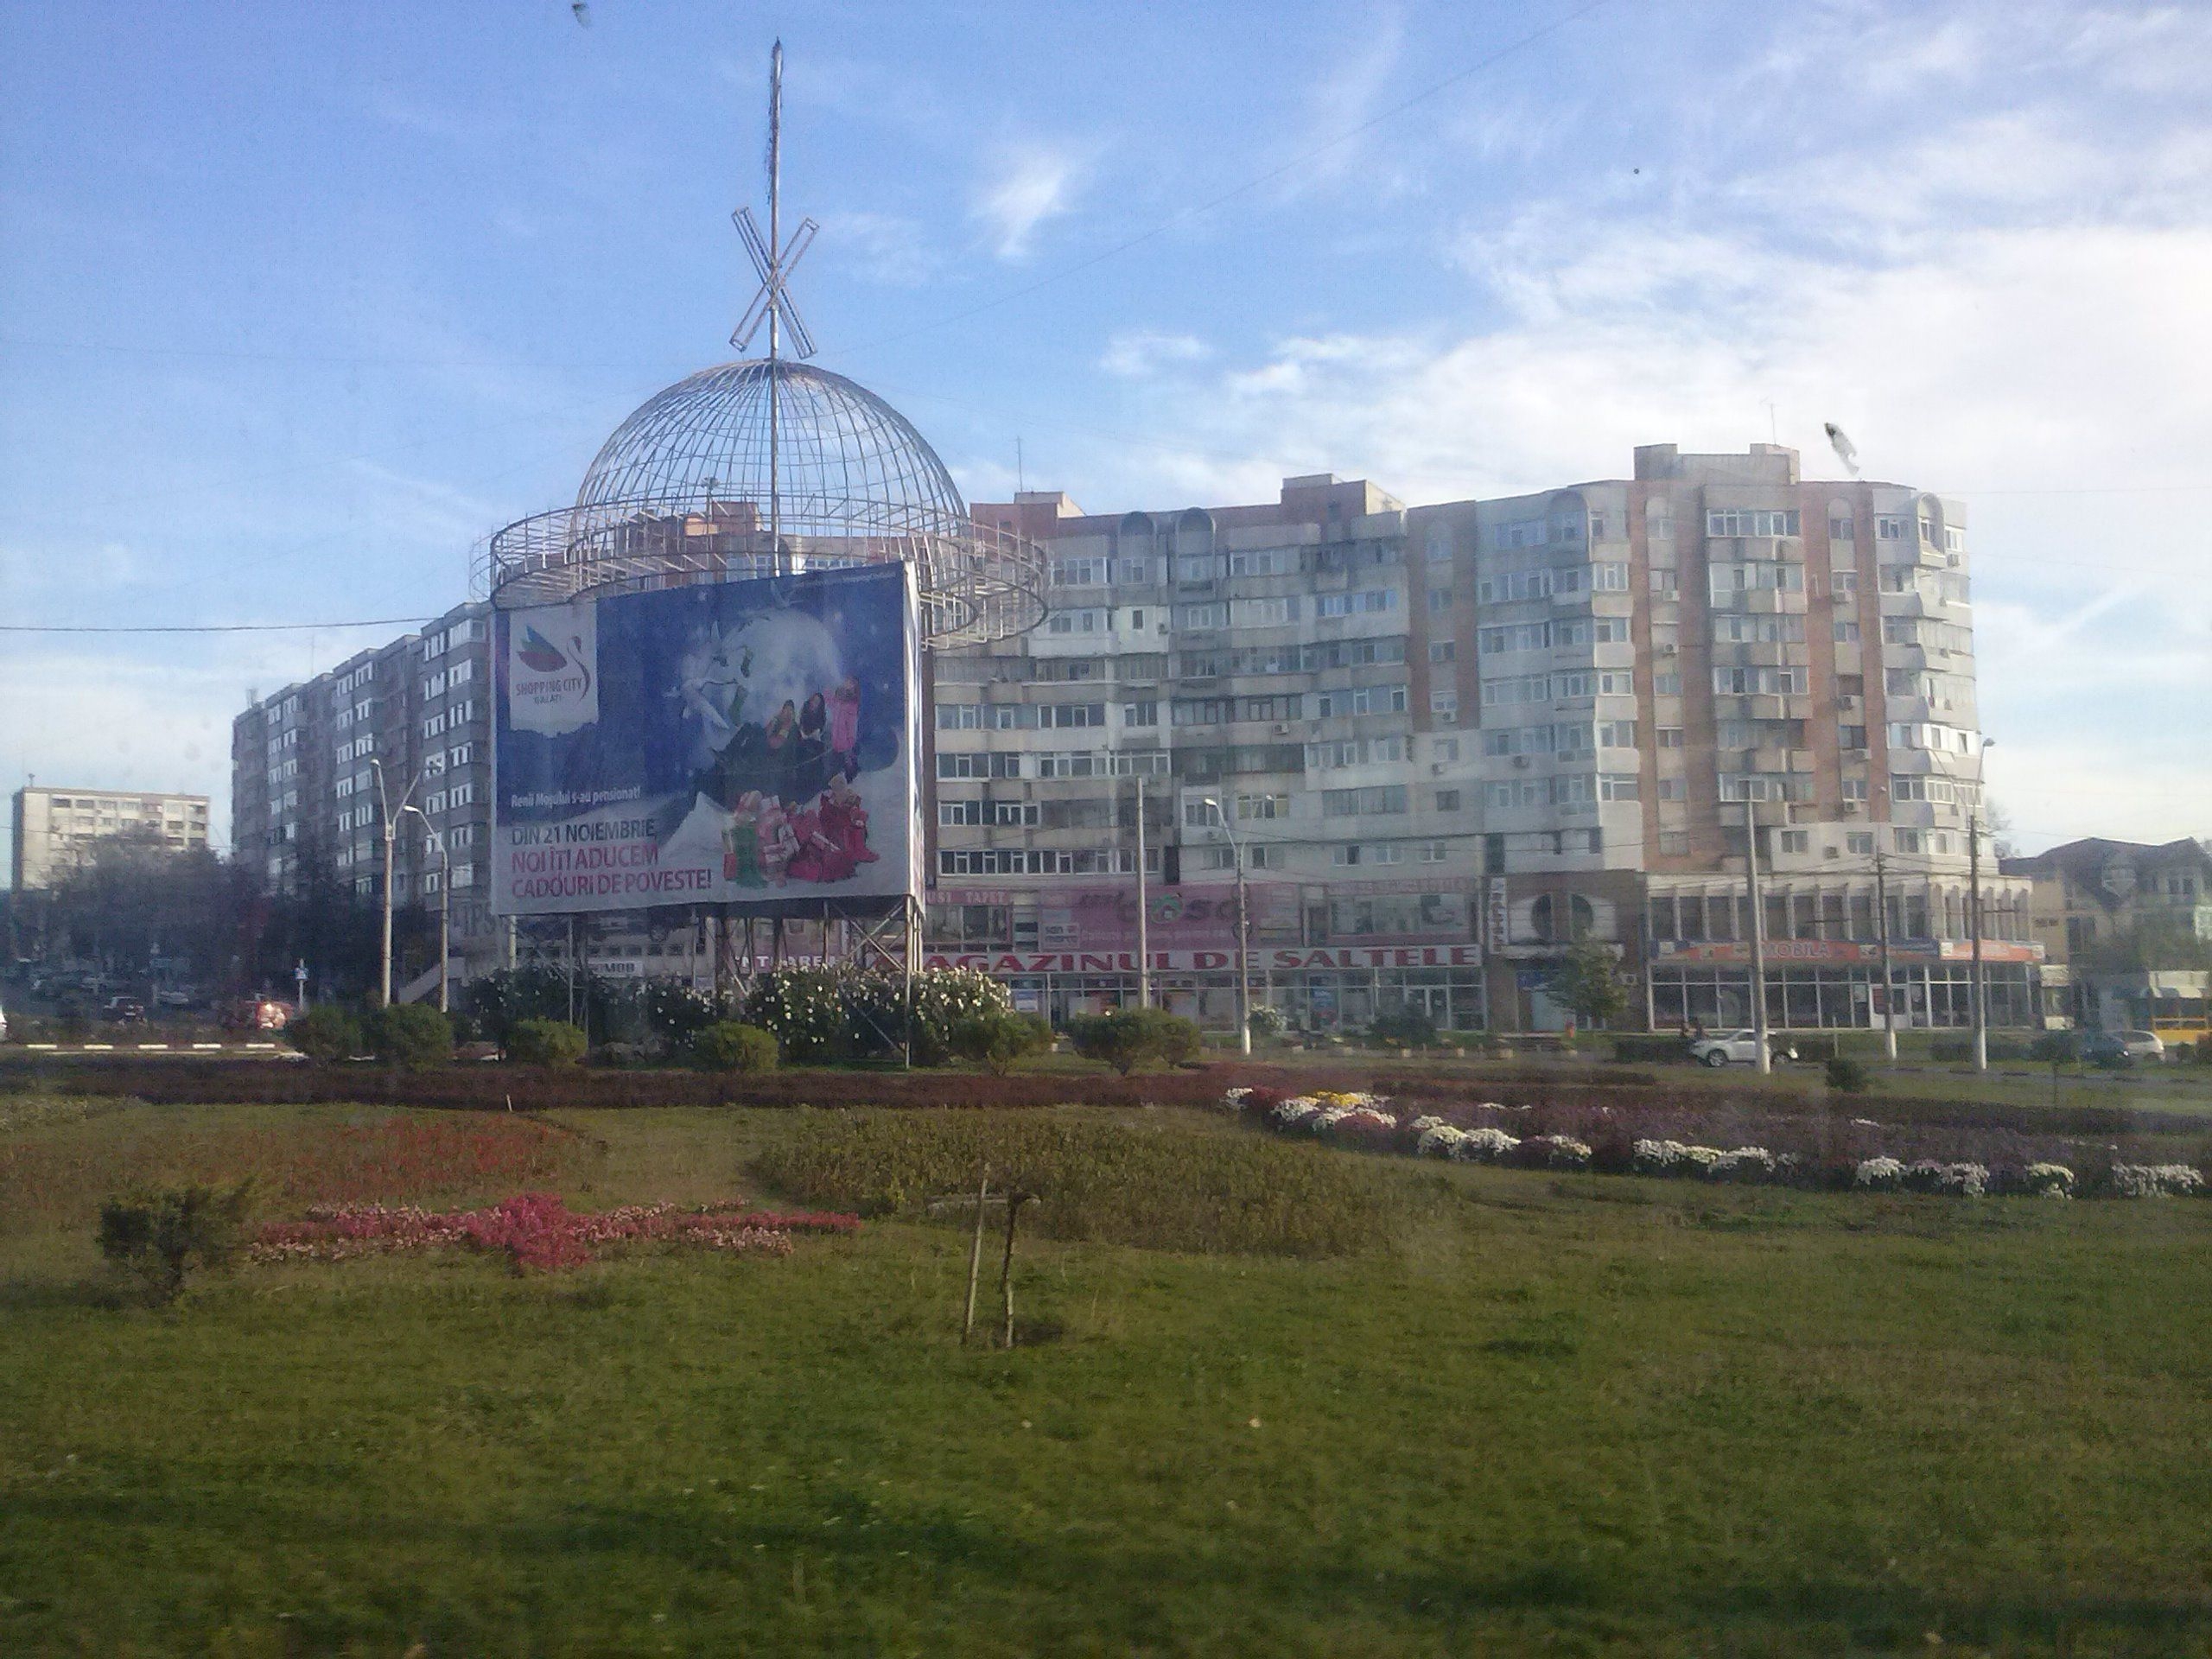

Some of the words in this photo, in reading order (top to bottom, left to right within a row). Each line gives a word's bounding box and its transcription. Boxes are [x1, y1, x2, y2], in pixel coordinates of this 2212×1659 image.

[516, 679, 562, 696] SHOPPING
[563, 677, 582, 692] CITY
[512, 826, 540, 846] DIN
[543, 825, 561, 844] 21
[565, 818, 656, 843] NOIEMBRIE
[512, 850, 546, 873] NOI
[575, 842, 659, 868] ADUCEM
[512, 874, 594, 899] CADOURI
[597, 873, 621, 895] DE
[625, 868, 713, 893] POVESTE!
[1193, 951, 1259, 969] DE
[1274, 947, 1477, 969] SALTELE
